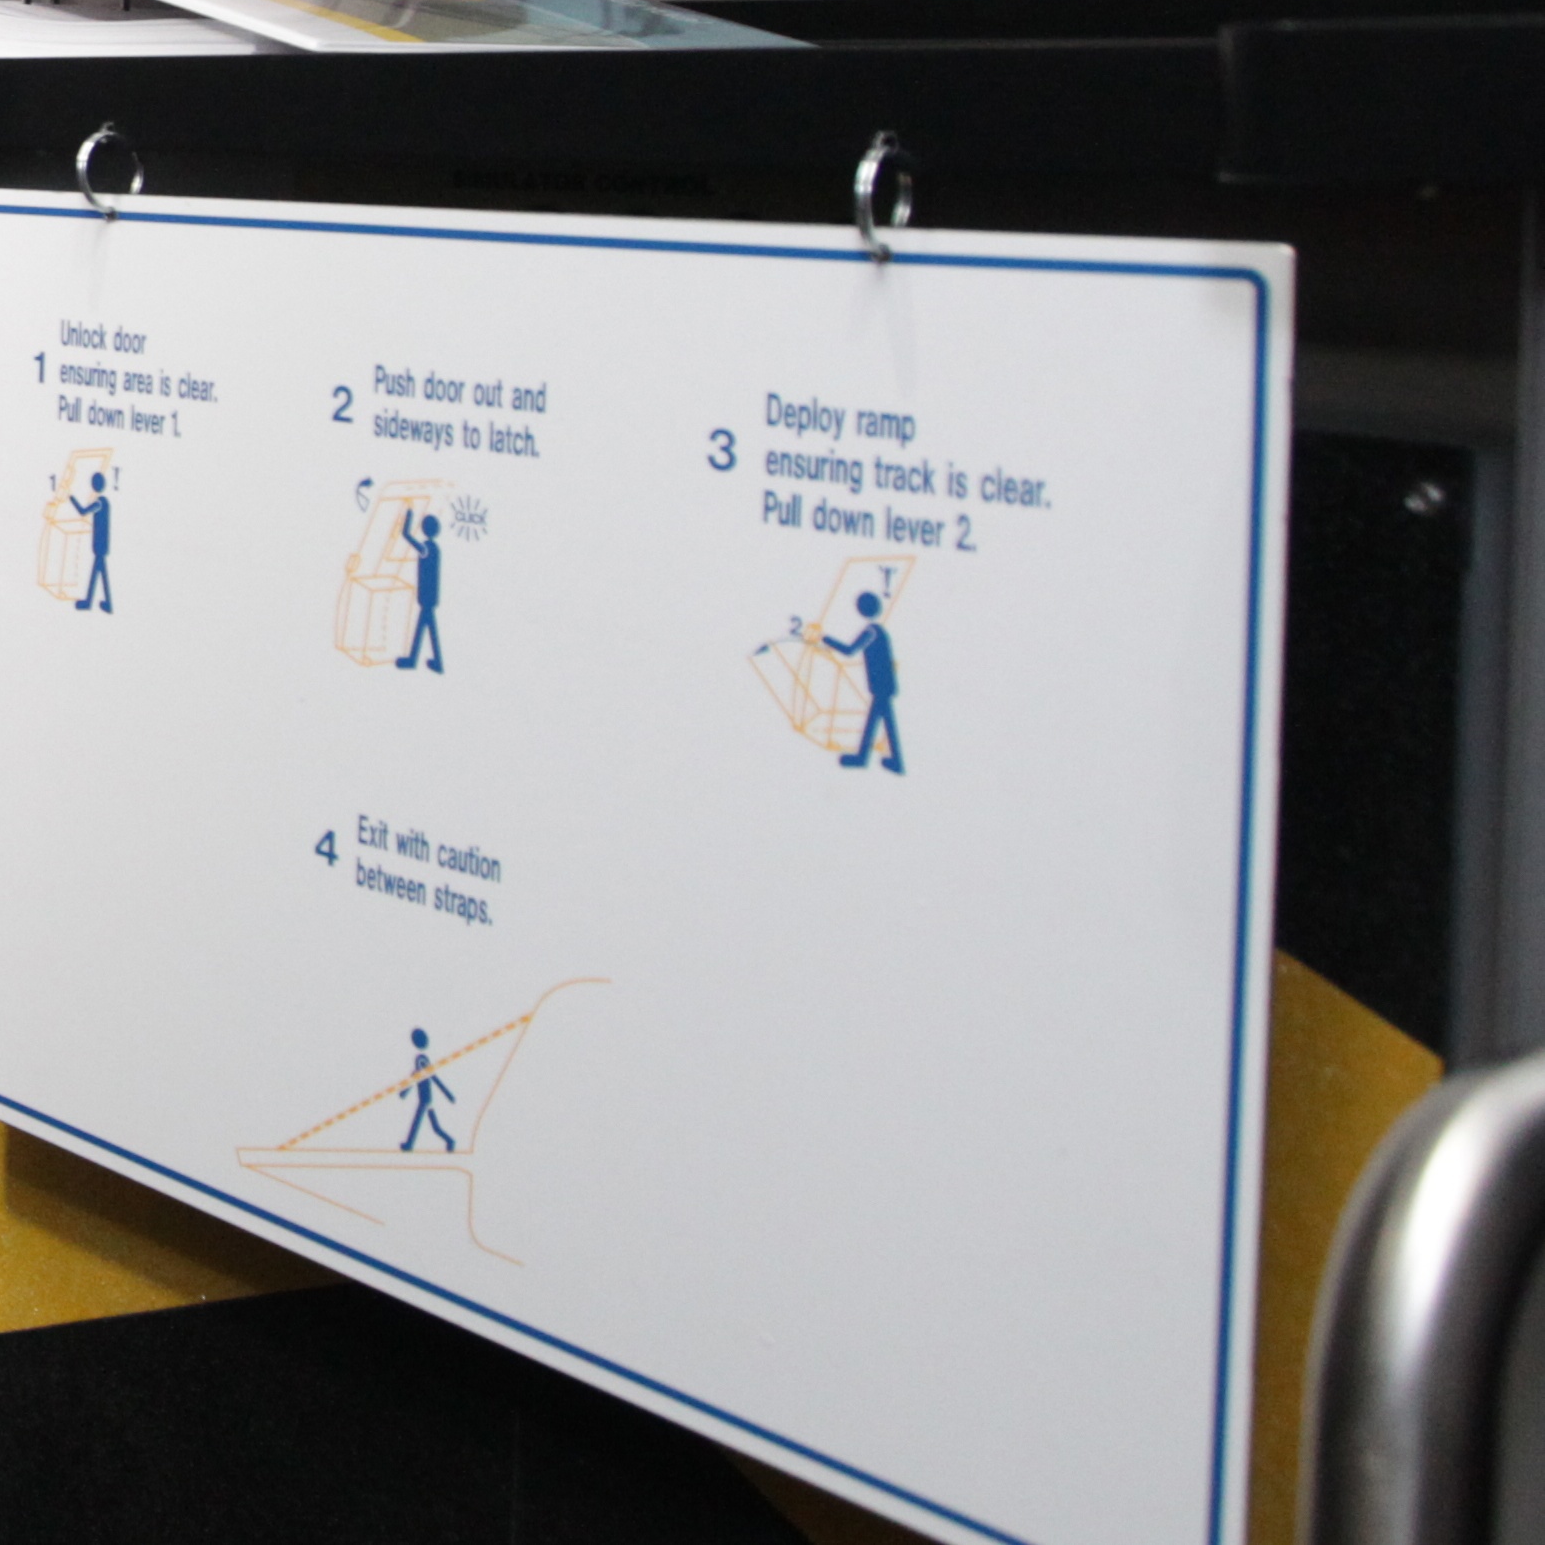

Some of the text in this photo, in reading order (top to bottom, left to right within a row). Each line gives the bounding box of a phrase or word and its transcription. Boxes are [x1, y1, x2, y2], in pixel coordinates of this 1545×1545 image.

[60, 319, 147, 355] Unlock door
[34, 351, 46, 383] 1
[59, 361, 218, 403] ensuring area is clear.
[331, 385, 354, 424] 2
[374, 364, 547, 414] Push door out and
[57, 394, 82, 423] Pull
[87, 400, 125, 430] down
[130, 404, 166, 435] lever
[373, 408, 540, 458] sideways to latch.
[766, 392, 916, 449] Deploy ramp
[707, 428, 738, 473] 3
[48, 473, 57, 492] 1
[765, 448, 1052, 509] ensuring track is clear.
[762, 489, 977, 554] Pull down lever 2.
[789, 615, 803, 637] 2
[314, 829, 339, 867] 4
[357, 813, 502, 884] Exit with caution
[356, 856, 493, 927] between straps.
